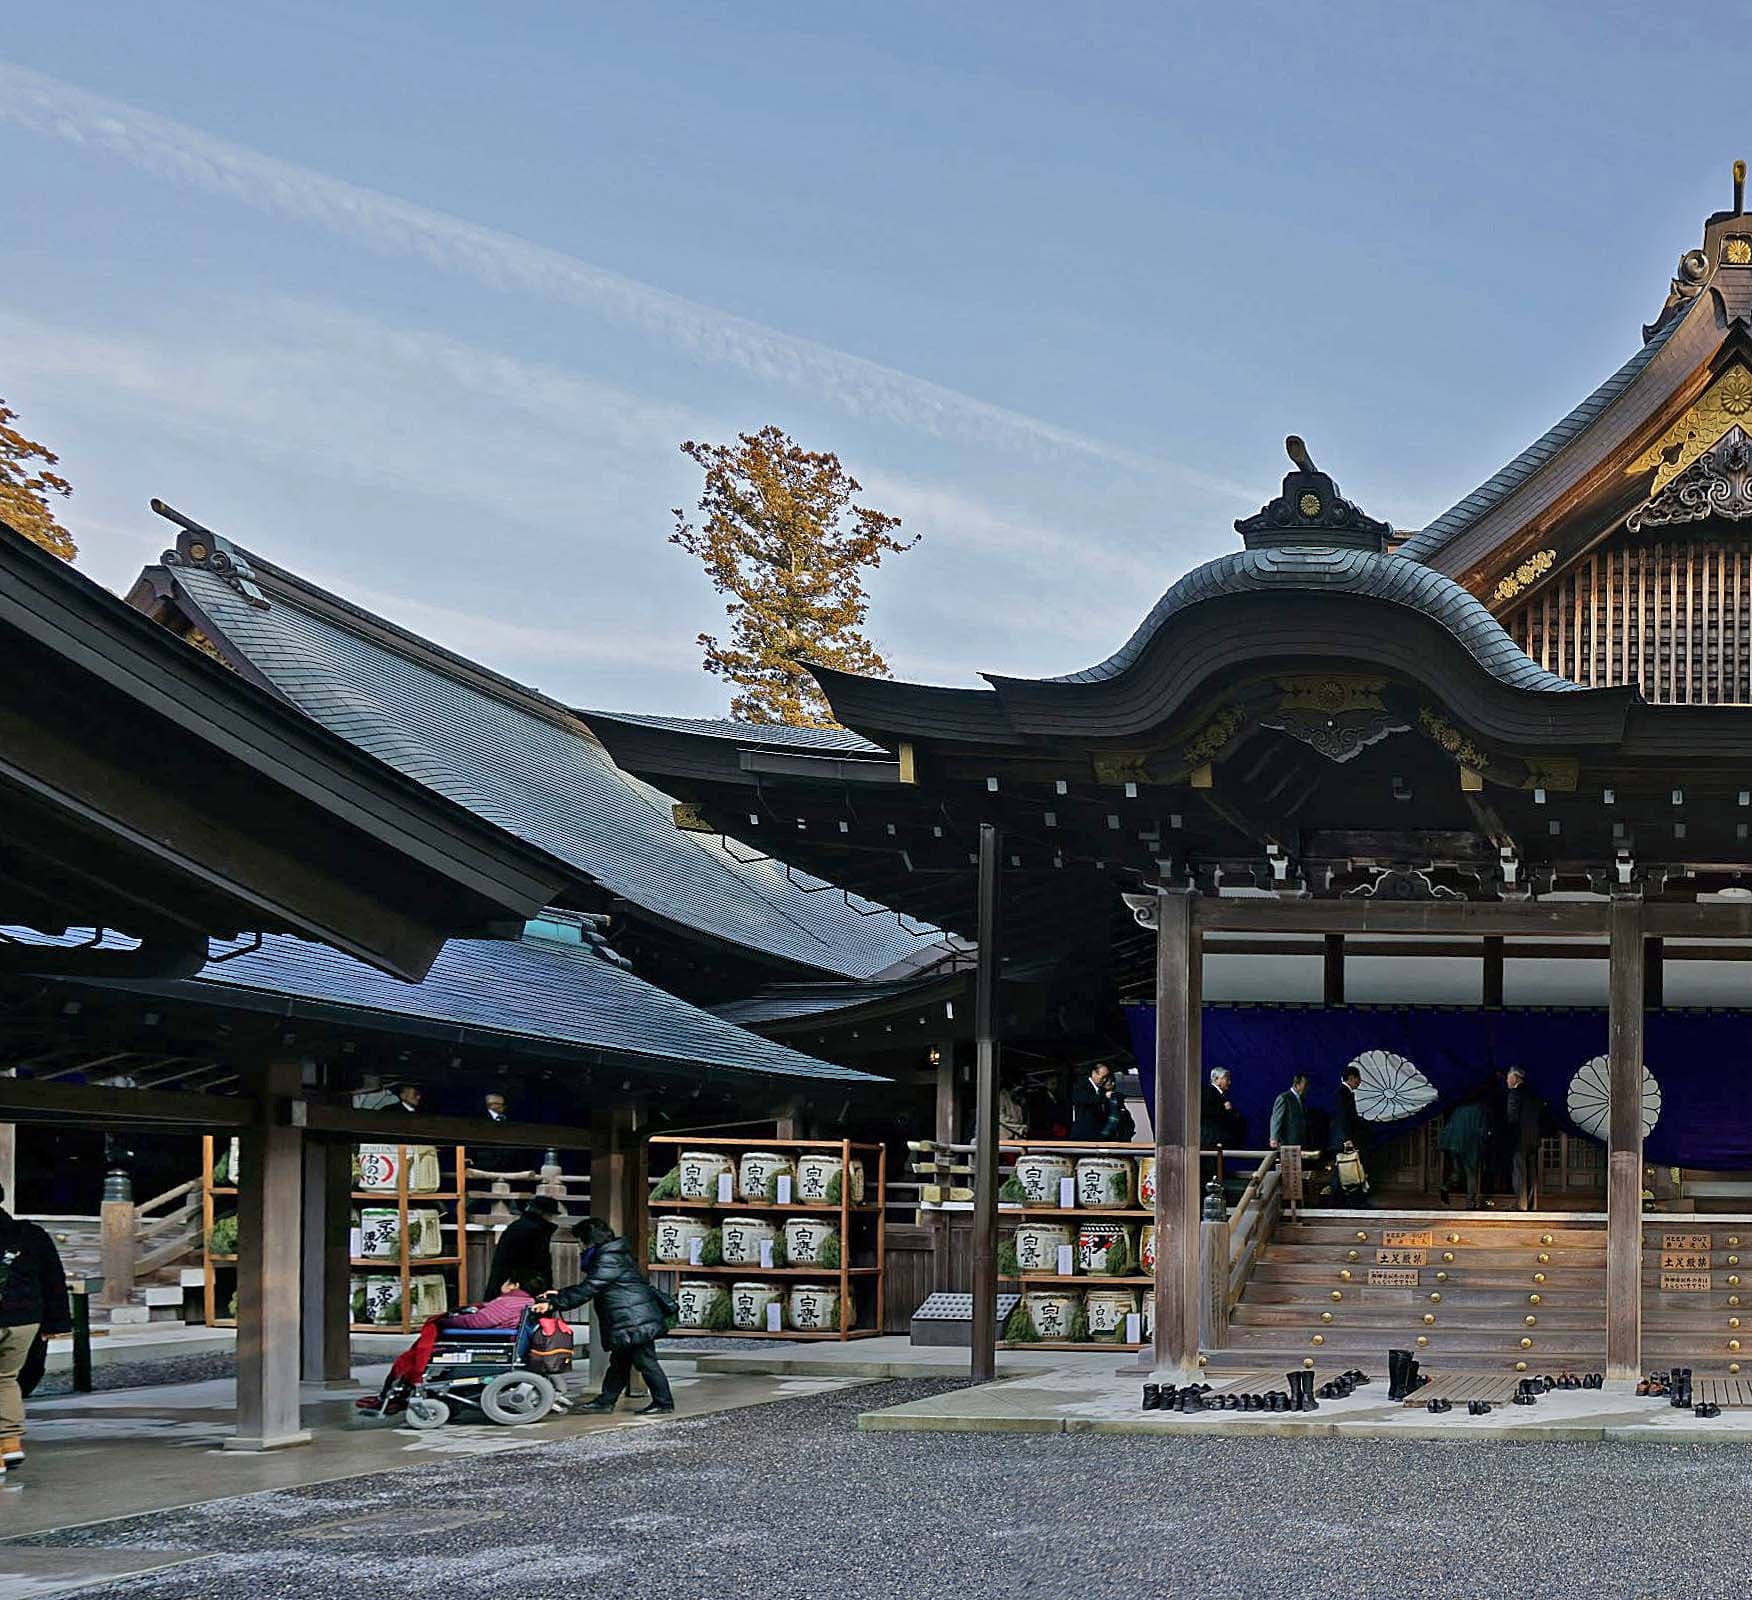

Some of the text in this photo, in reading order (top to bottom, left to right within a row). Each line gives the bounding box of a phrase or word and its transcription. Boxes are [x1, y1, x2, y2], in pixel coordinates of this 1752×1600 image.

[366, 1154, 379, 1186] ねのひ
[1380, 1253, 1422, 1265] 土足厳禁
[1664, 1257, 1707, 1267] 土足厳禁
